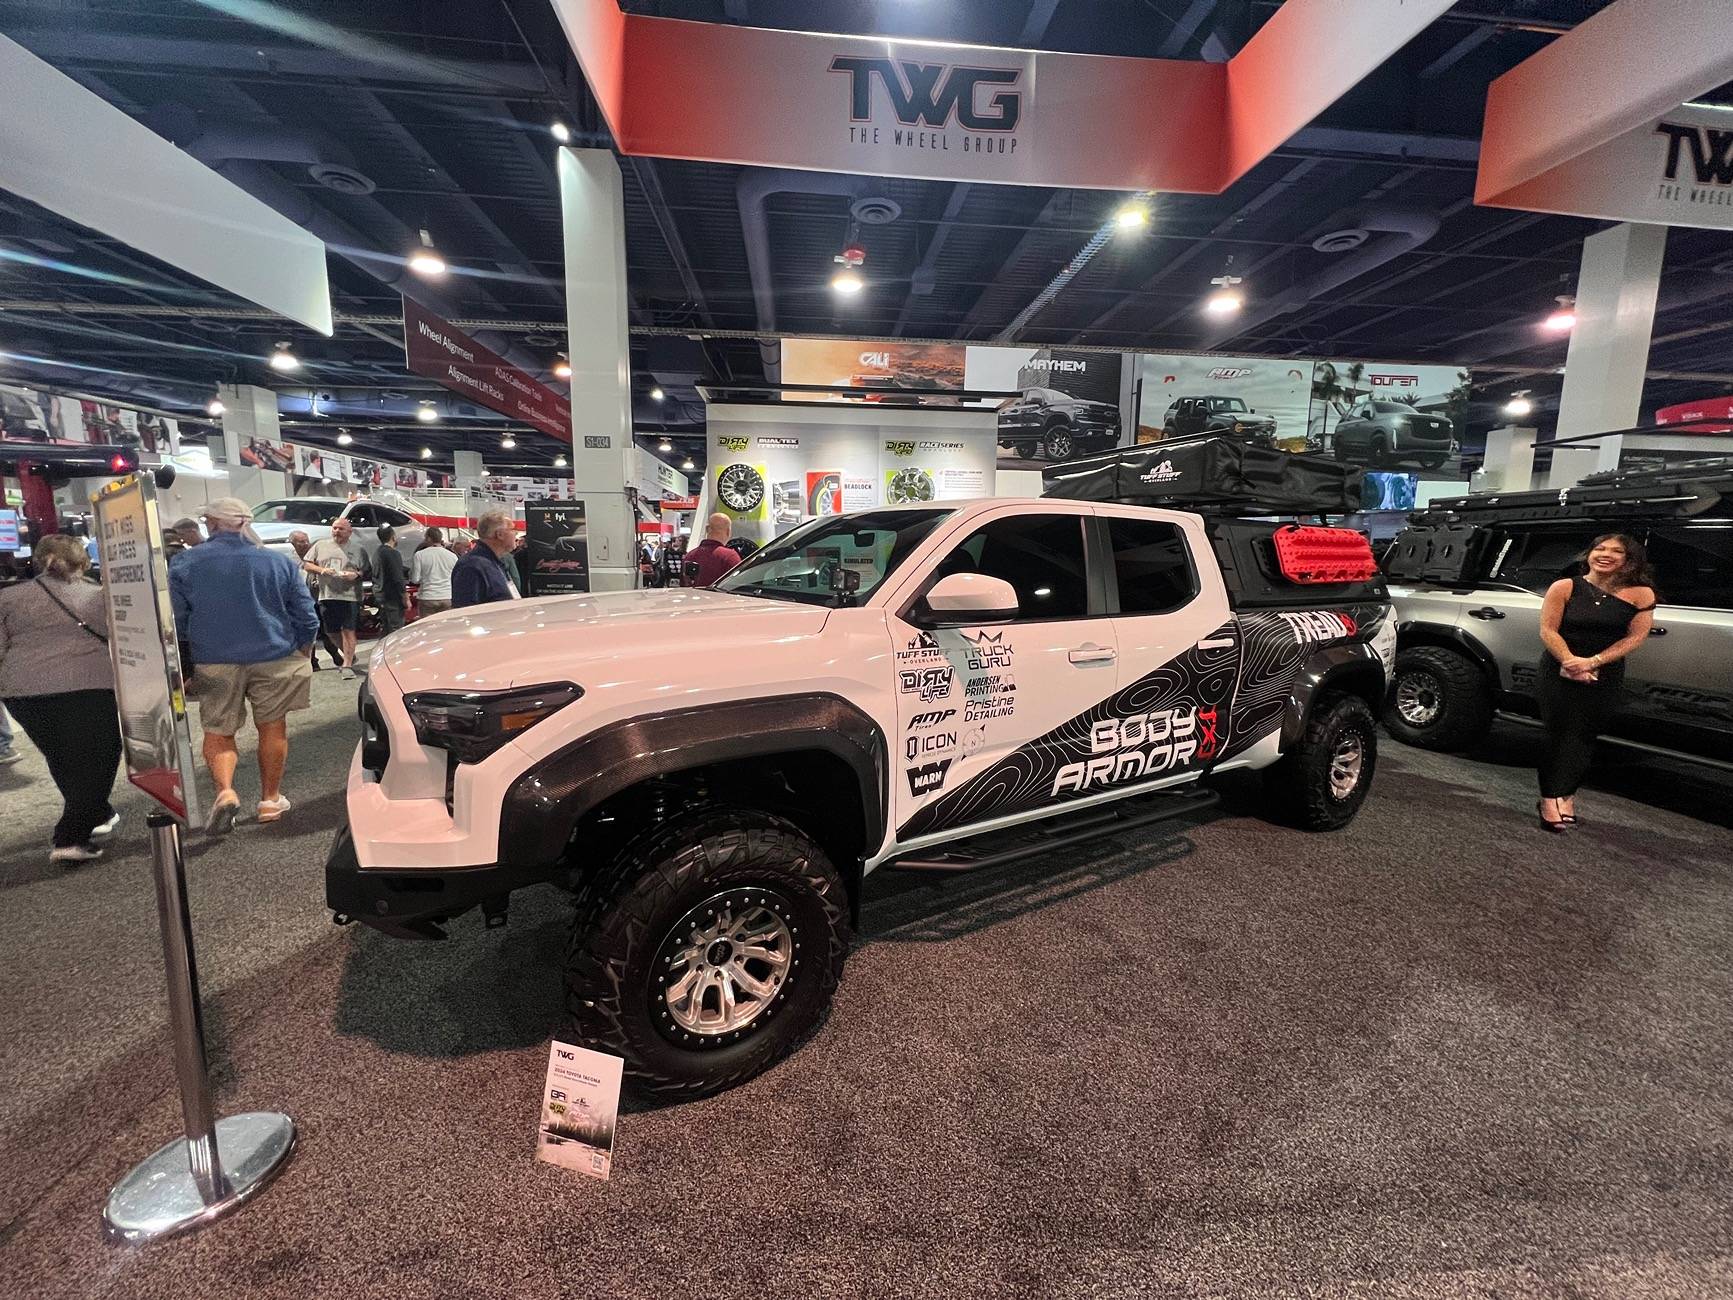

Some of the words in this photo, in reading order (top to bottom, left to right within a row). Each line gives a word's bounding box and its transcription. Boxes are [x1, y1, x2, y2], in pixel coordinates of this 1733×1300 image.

[827, 55, 1023, 133] TWG
[849, 127, 879, 144] THE
[894, 130, 948, 150] WHEEL
[964, 136, 1017, 154] GROUP
[1659, 185, 1681, 201] THE
[418, 320, 442, 345] Wheel
[442, 336, 474, 363] Alignment
[1024, 359, 1086, 373] MAYHEM
[448, 365, 479, 389] Alignment
[479, 380, 489, 394] Lift
[489, 384, 505, 401] Racks
[586, 436, 609, 447] S1-034
[1277, 611, 1347, 644] TREAD
[896, 650, 919, 660] TUFF
[963, 644, 1014, 659] TRUCK
[968, 656, 1011, 670] GURU
[900, 667, 955, 691] DIRTY
[967, 675, 1001, 688] ANDERSEN
[920, 684, 951, 701] LIFE
[964, 684, 1004, 697] PRINTING
[964, 697, 1015, 711] Pristine
[908, 709, 957, 731] AMP
[964, 707, 1014, 722] DETAILING
[1090, 706, 1197, 752] BODY
[922, 731, 957, 752] ICON
[1050, 739, 1197, 797] ARMOR
[914, 770, 943, 789] WARN
[556, 1049, 575, 1061] TWG
